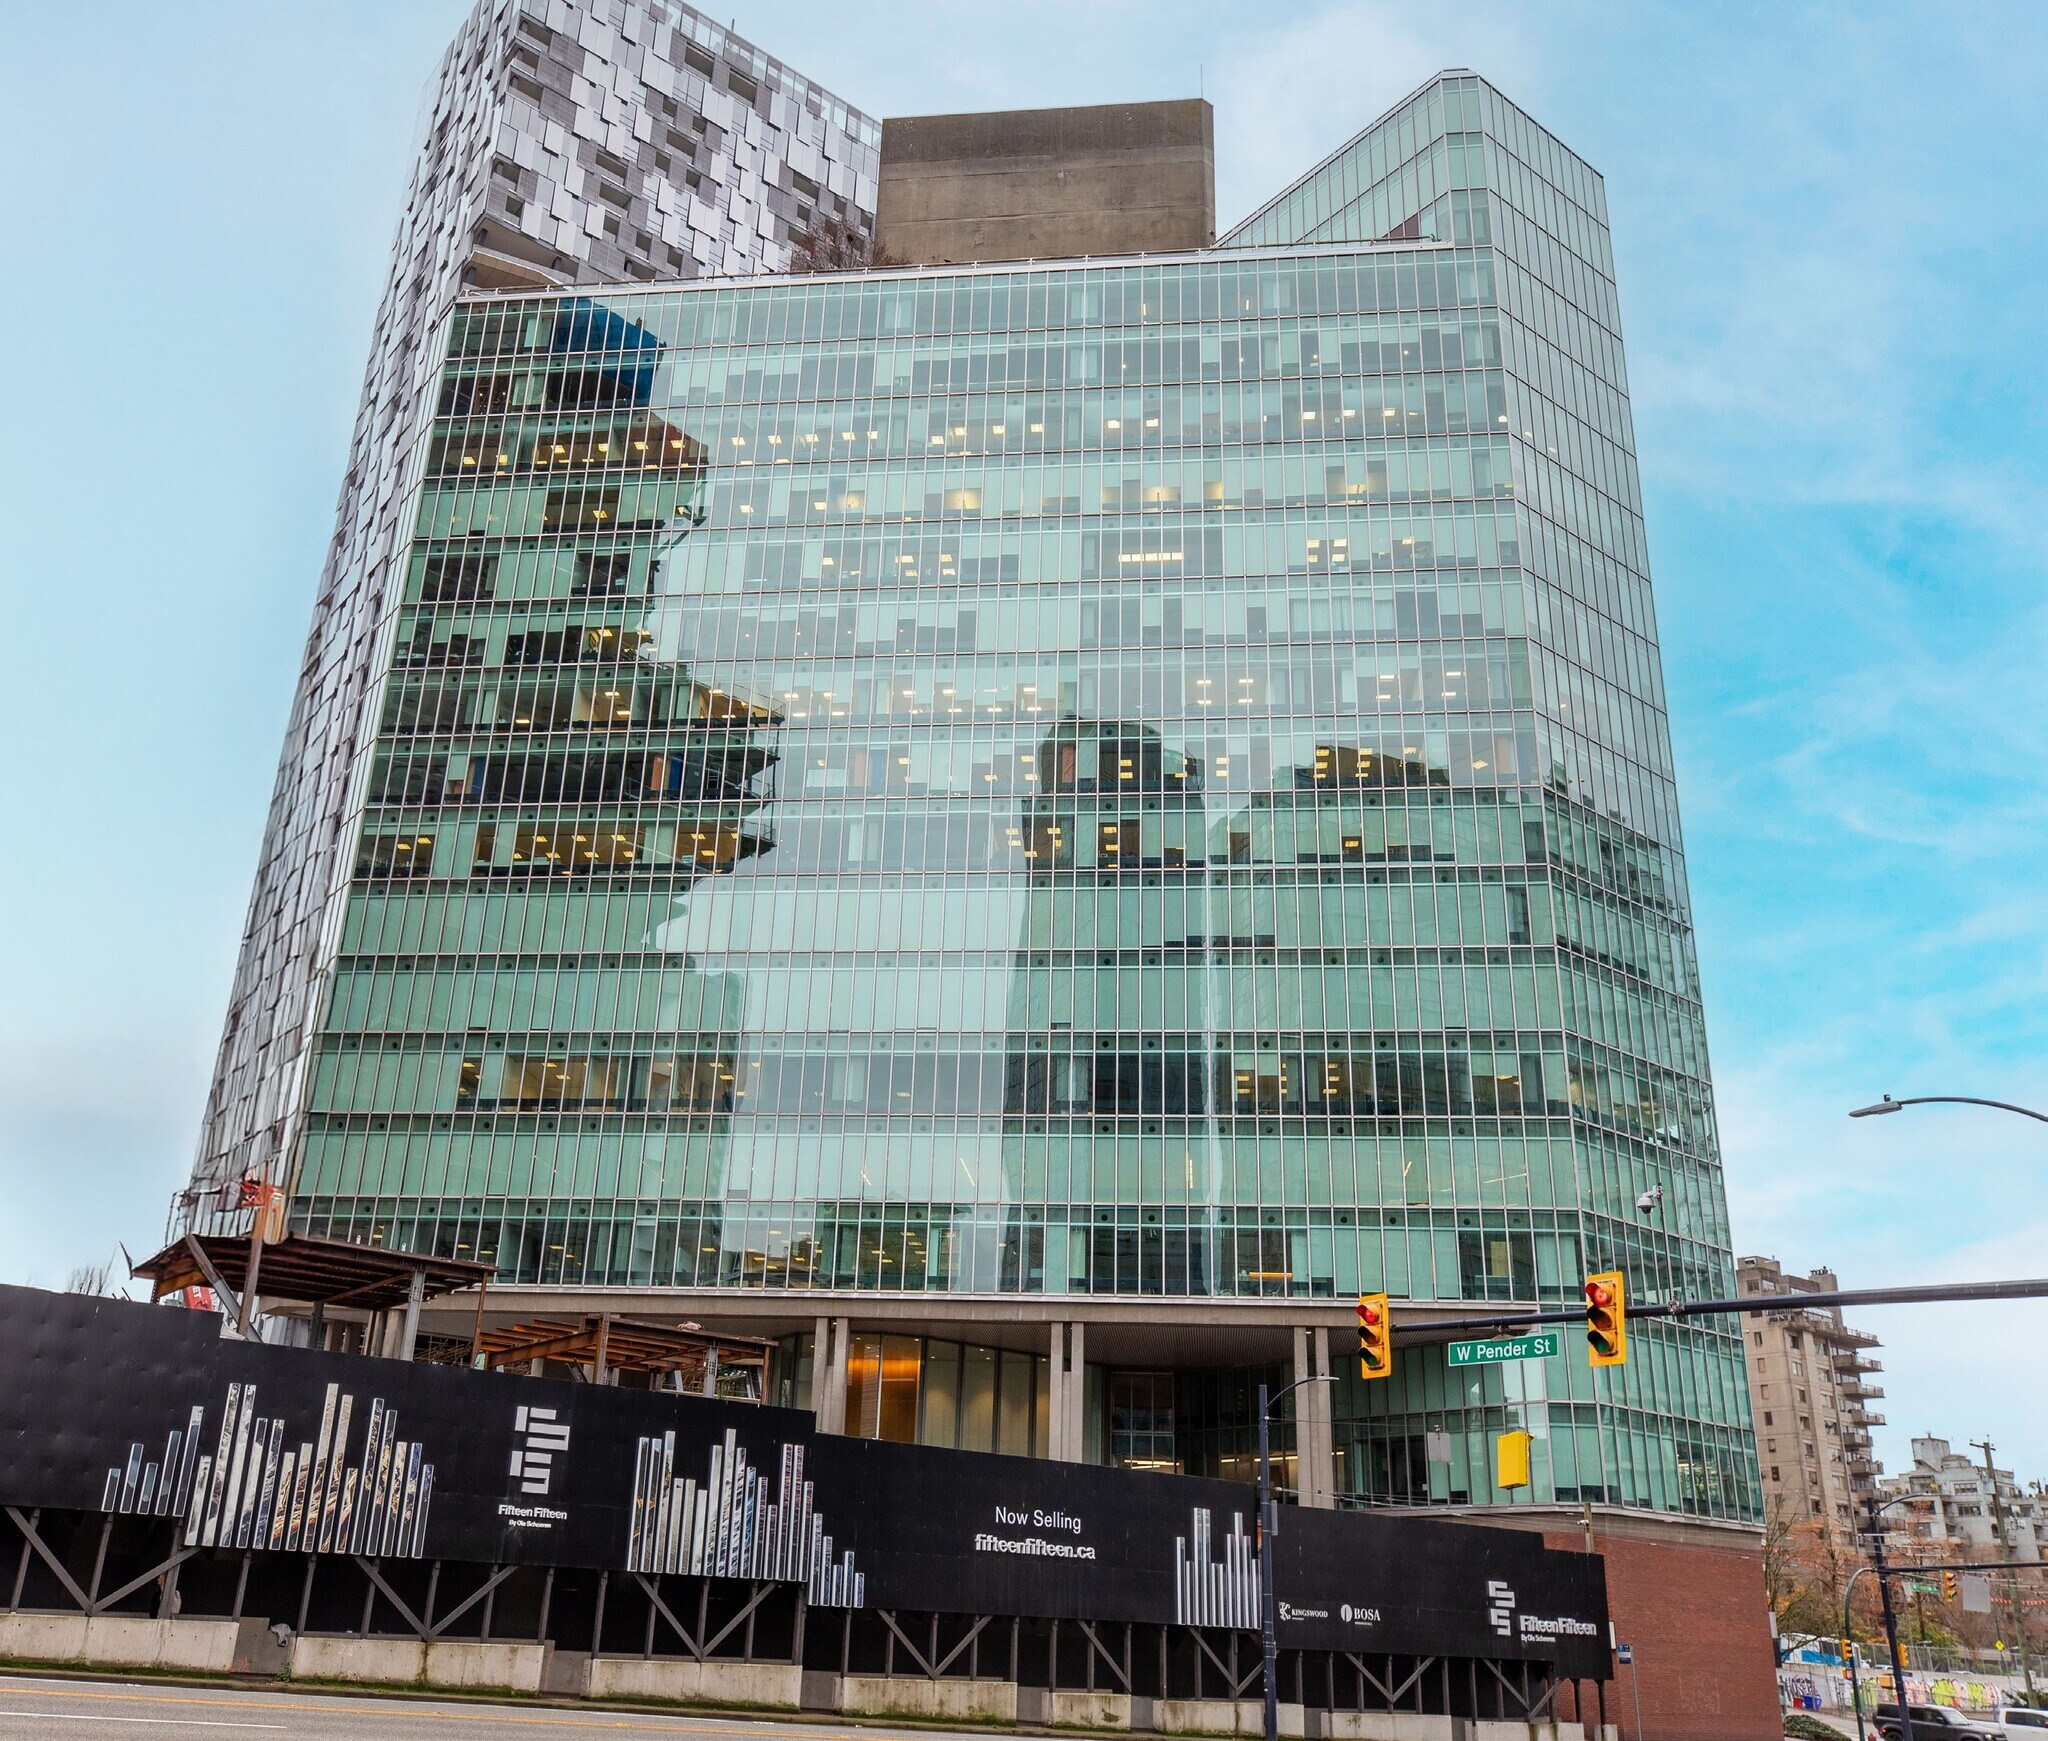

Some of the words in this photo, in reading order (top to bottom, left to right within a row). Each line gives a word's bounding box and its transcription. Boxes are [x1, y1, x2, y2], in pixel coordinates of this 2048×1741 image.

[1456, 1345, 1471, 1361] W
[1476, 1341, 1528, 1360] Pender
[1533, 1338, 1551, 1355] St
[498, 1504, 533, 1517] Fifteen
[533, 1507, 568, 1520] Fifteen
[995, 1505, 1028, 1525] Now
[1033, 1509, 1081, 1534] Selling
[975, 1533, 1096, 1560] fifteenfifteen.ca
[1291, 1608, 1329, 1618] KINGSWOOD
[1353, 1607, 1381, 1621] BOSA
[1519, 1615, 1559, 1633] Fifteen
[1558, 1617, 1597, 1636] Fifteen
